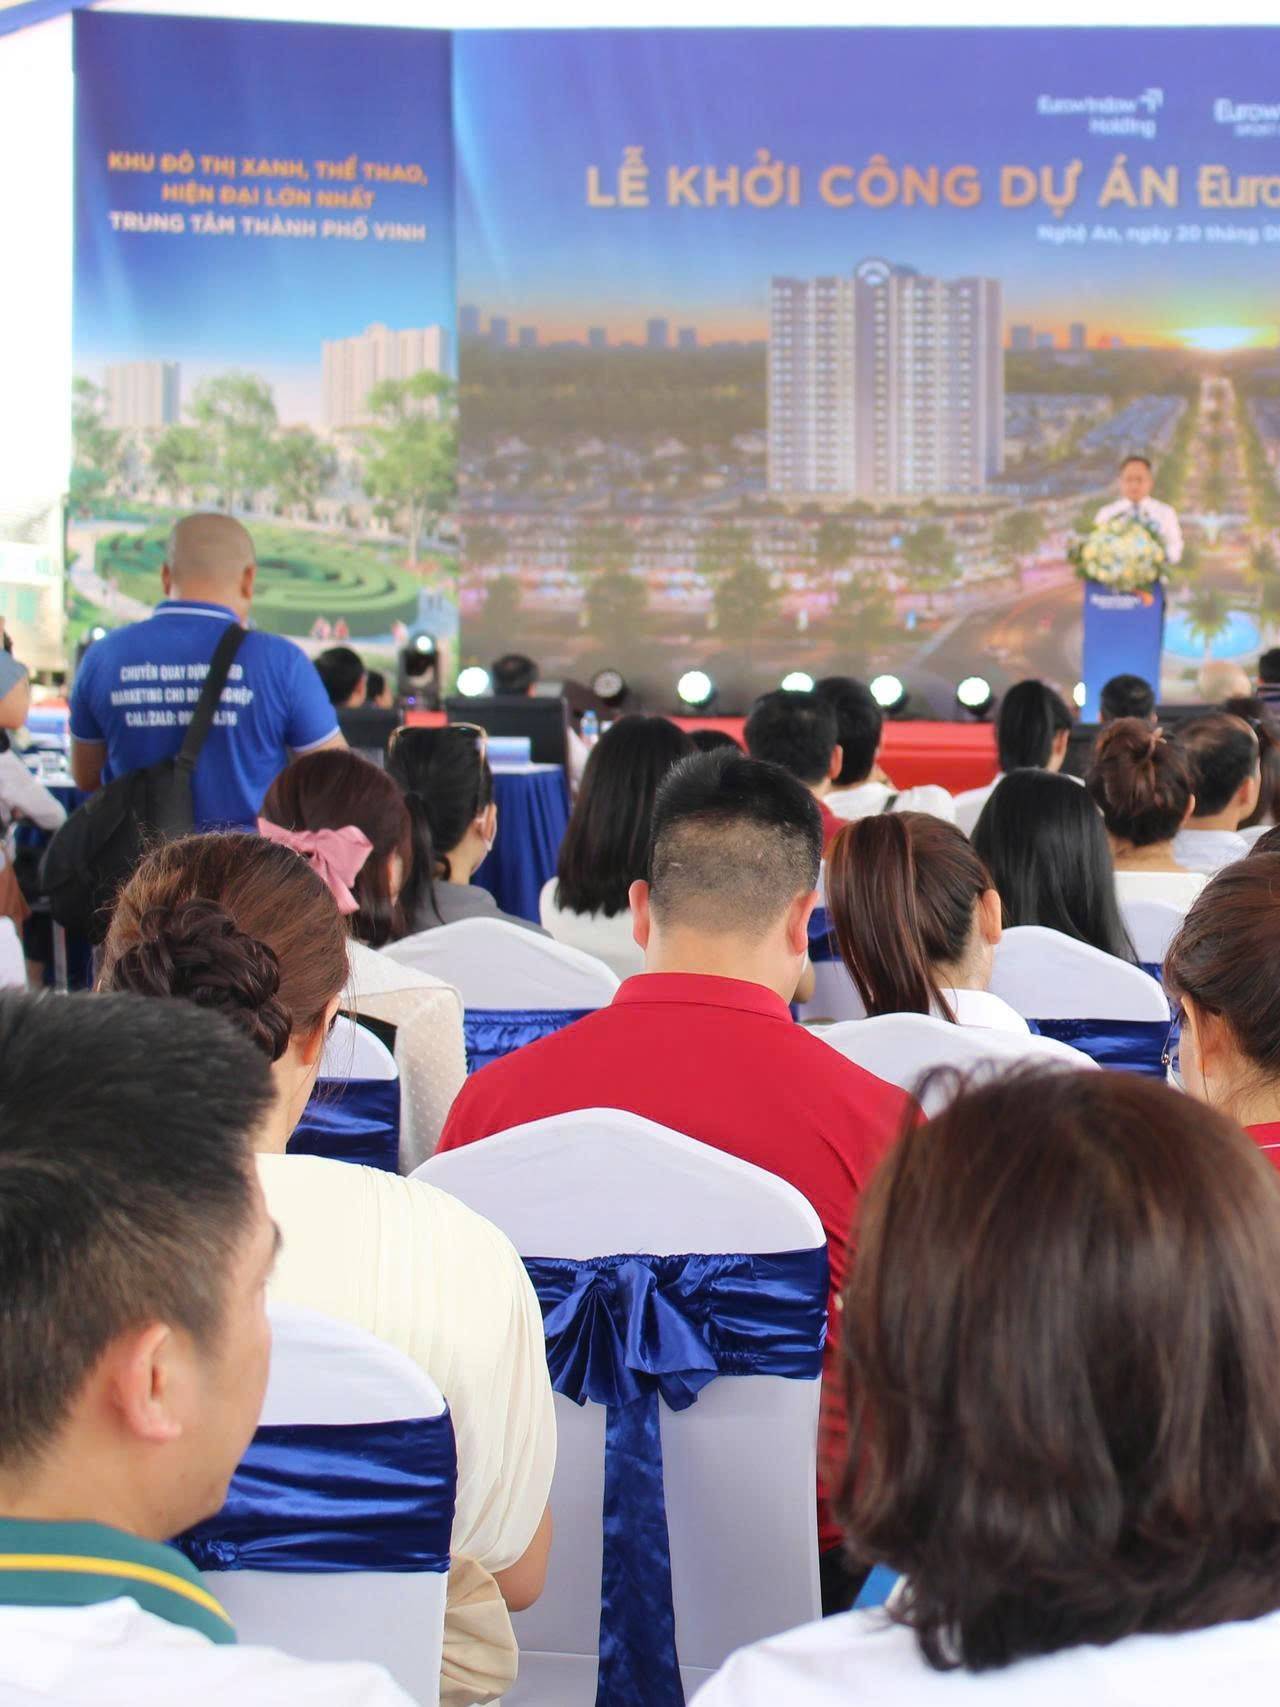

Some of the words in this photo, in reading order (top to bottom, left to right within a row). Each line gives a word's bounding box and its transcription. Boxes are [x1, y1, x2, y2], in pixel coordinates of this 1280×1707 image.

[107, 151, 155, 173] KHU
[587, 146, 649, 207] LỄ
[667, 147, 801, 207] KHỞI
[819, 154, 982, 207] CÔNG
[1000, 158, 1083, 219] DỰ
[1098, 153, 1178, 207] ÁN
[109, 211, 185, 234] TRUNG
[374, 222, 426, 241] VINH
